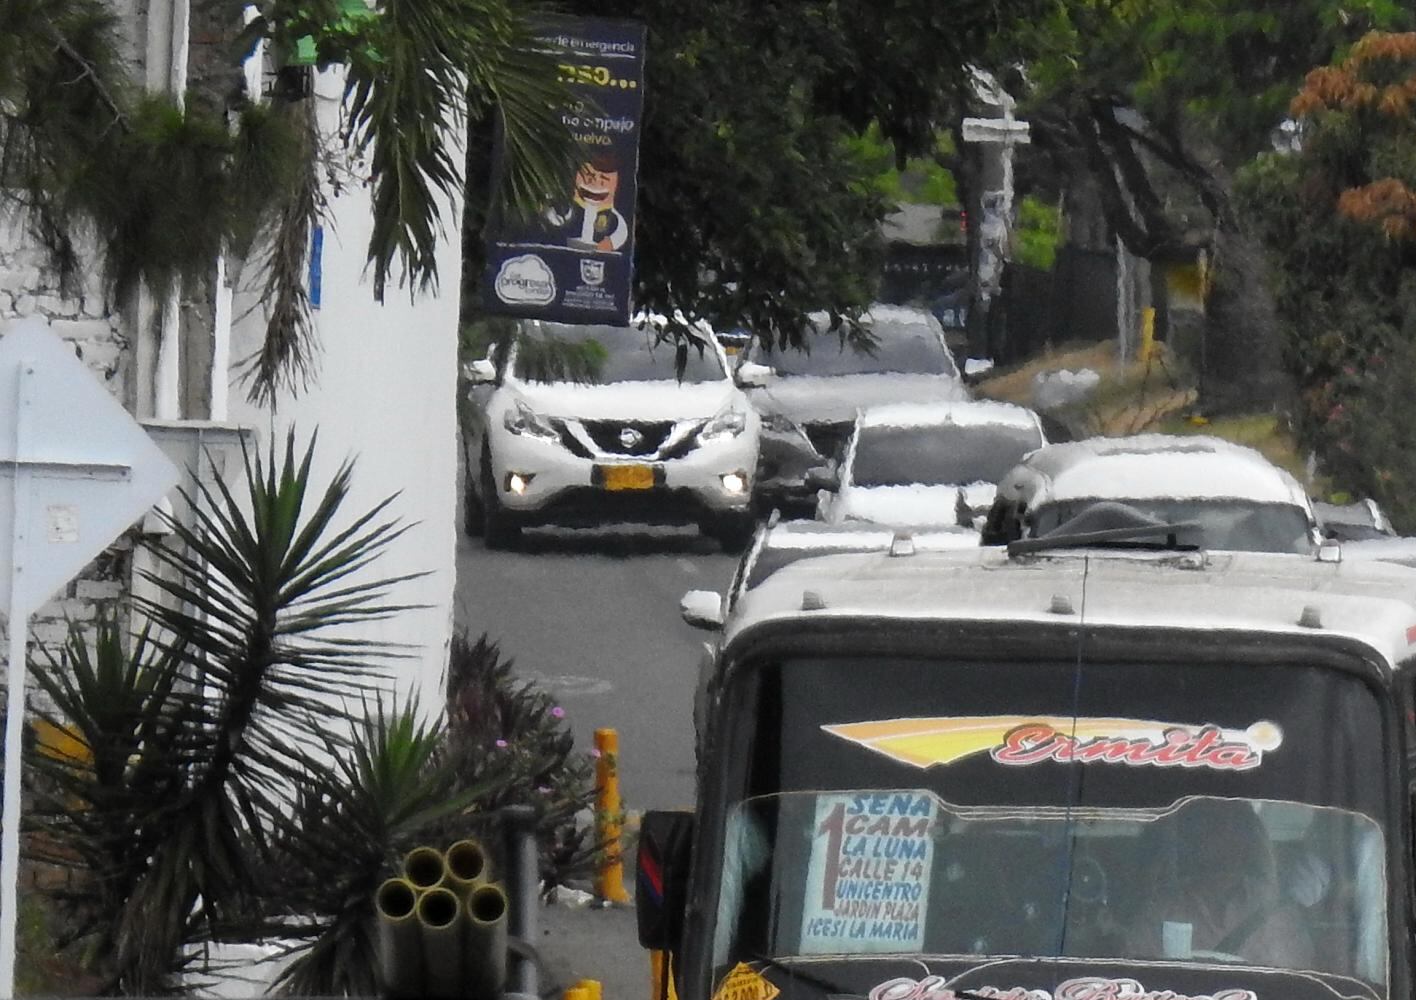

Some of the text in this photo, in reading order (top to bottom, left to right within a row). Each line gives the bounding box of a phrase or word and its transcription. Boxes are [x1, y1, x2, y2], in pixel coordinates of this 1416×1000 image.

[992, 722, 1261, 769] Ermita
[847, 794, 932, 817] SENA
[845, 814, 929, 837] CAM
[818, 802, 846, 911] 1
[842, 836, 927, 860] LA LUNA
[838, 857, 899, 880] CALLE
[836, 879, 923, 902] UNICENTRO
[833, 900, 920, 922] JARDIN PLAZA
[807, 918, 919, 941] ICESI LA MARIA
